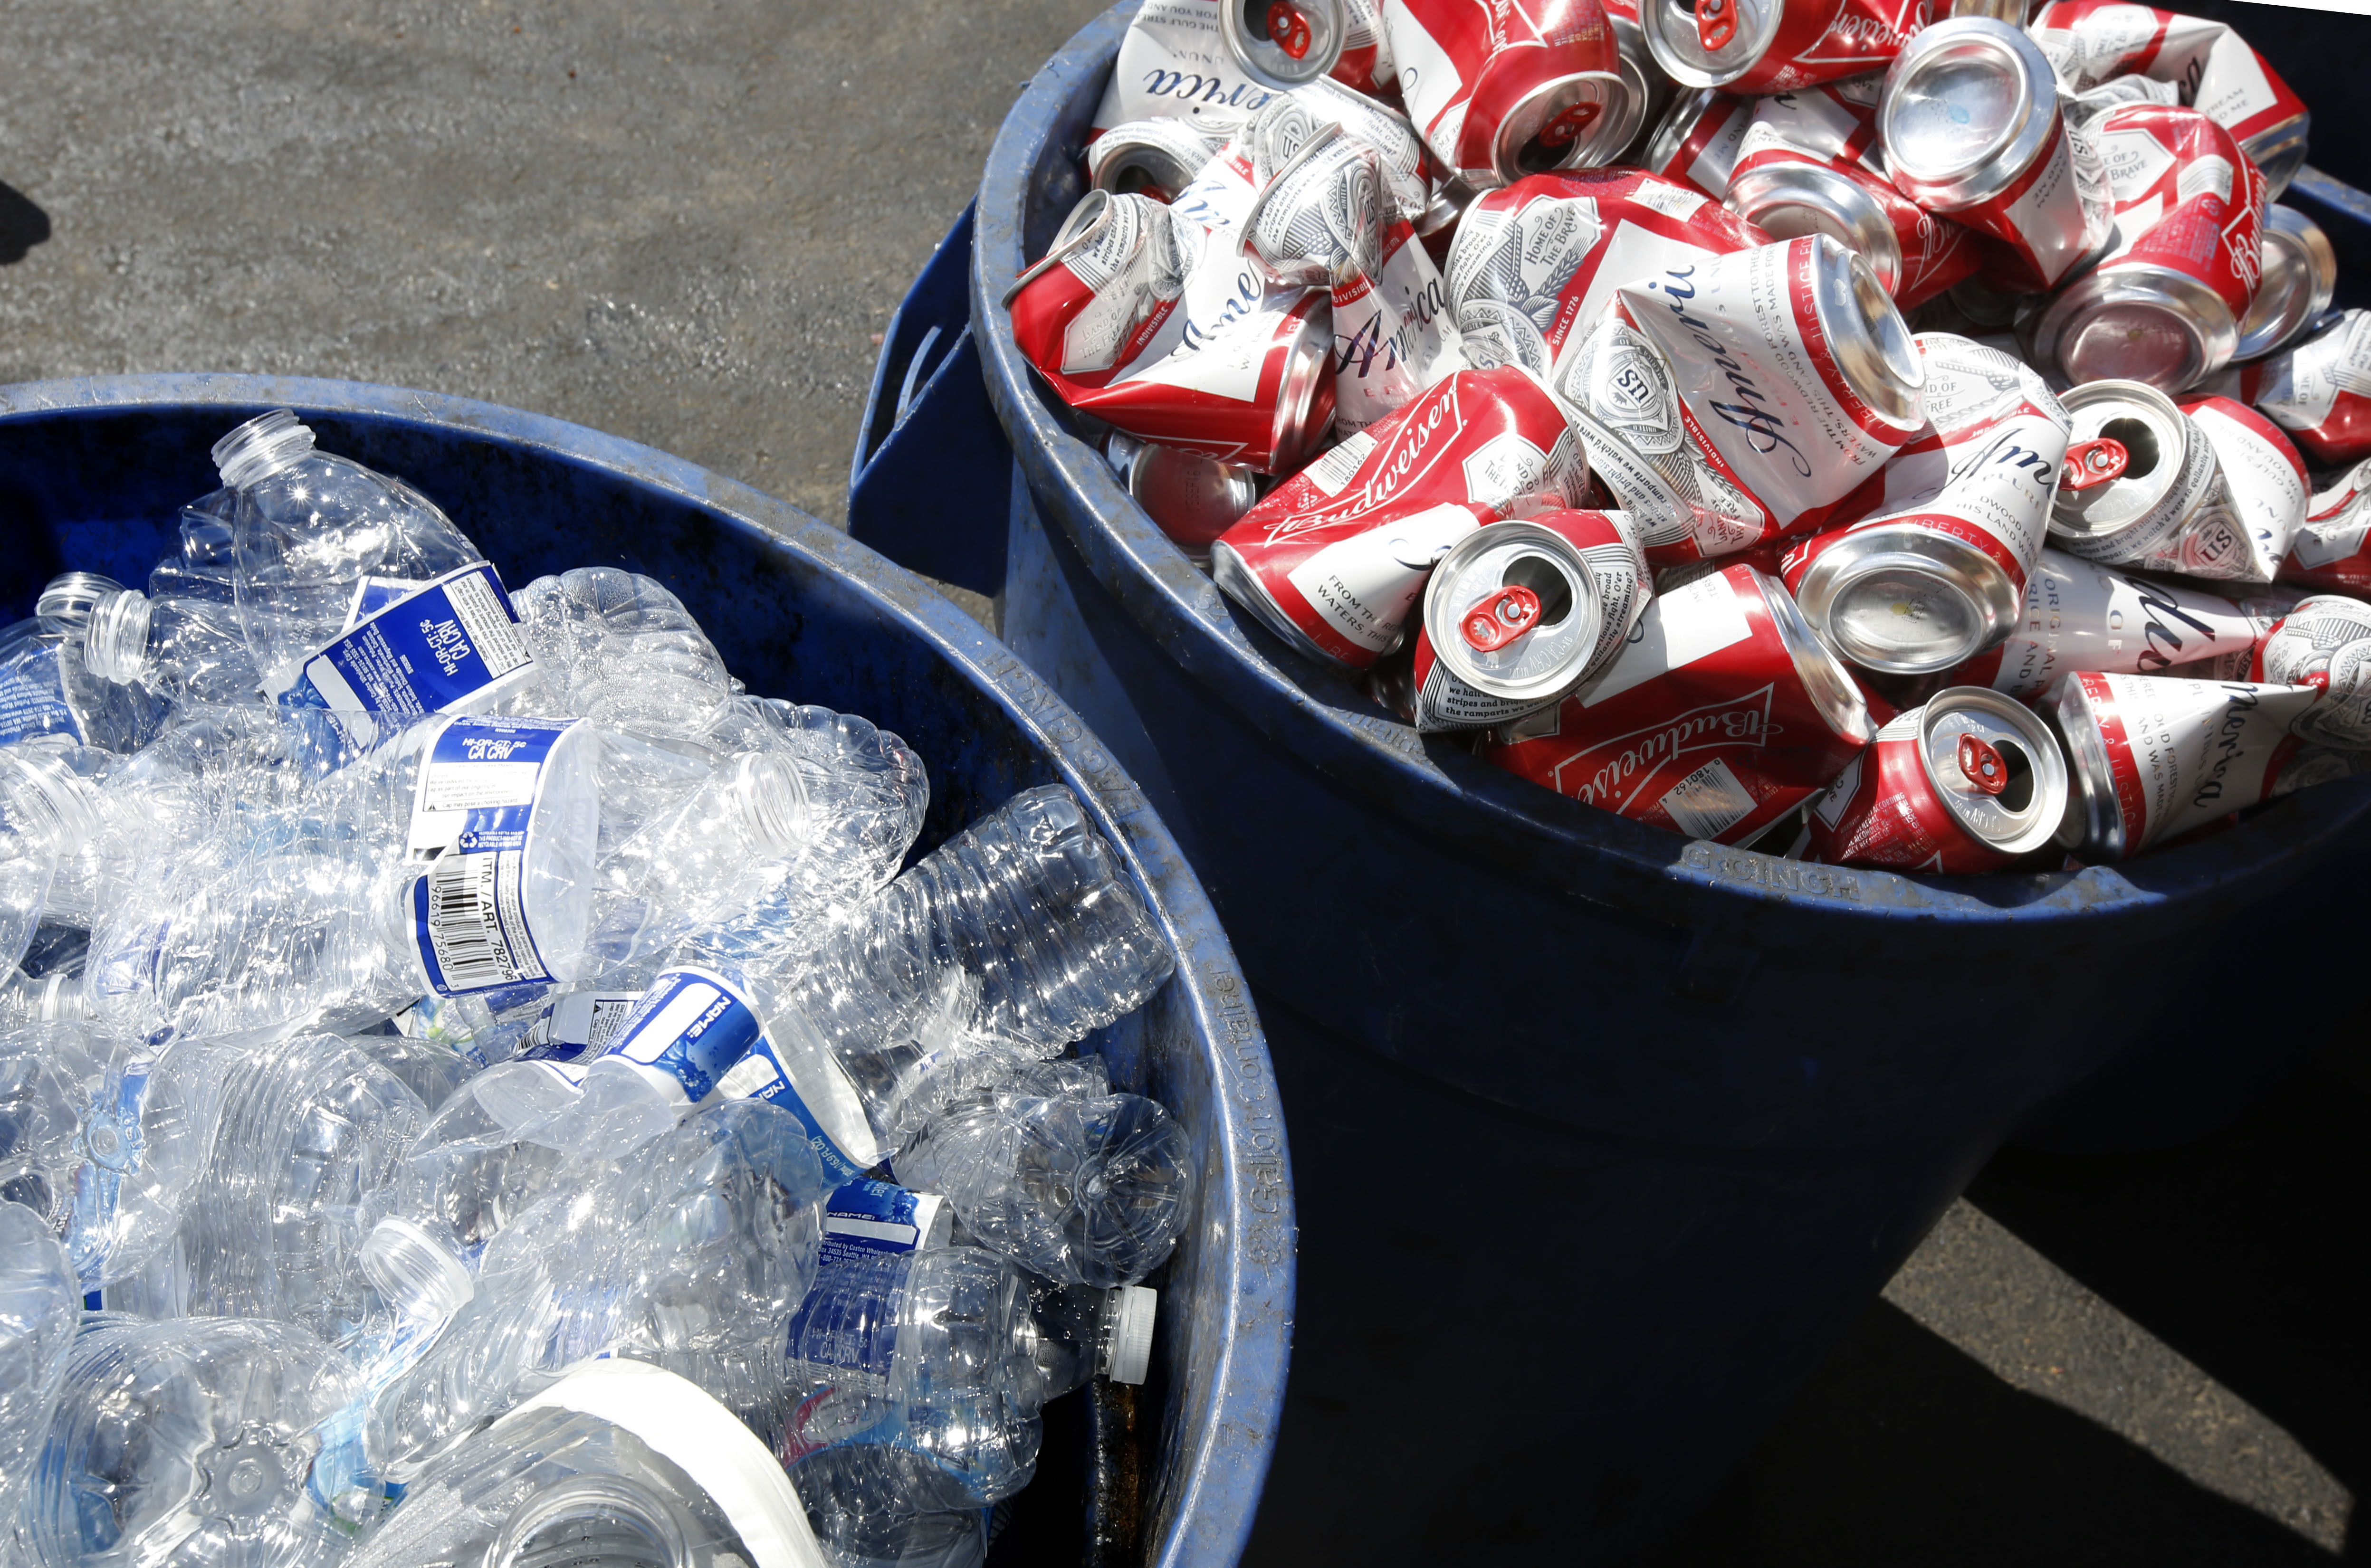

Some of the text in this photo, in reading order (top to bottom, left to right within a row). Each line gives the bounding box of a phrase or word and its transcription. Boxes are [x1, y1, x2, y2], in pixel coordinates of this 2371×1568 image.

[1169, 5, 1216, 21] FOR YOU
[1169, 17, 1197, 29] GULF
[2229, 98, 2251, 111] ME
[1382, 122, 1402, 142] broad
[1384, 133, 1400, 150] O'er
[2109, 160, 2148, 181] BRAVE
[2113, 152, 2127, 163] OF
[2031, 154, 2064, 201] AND ME
[1259, 190, 1291, 238] stripes and
[1260, 194, 1284, 233] we hail'd
[1267, 188, 1308, 244] the ramparts
[1363, 196, 1376, 225] US
[1090, 246, 1102, 259] we
[1096, 224, 1119, 266] stripes and
[1107, 223, 1136, 273] the ramparts
[1456, 233, 1488, 273] fight, O'er
[1460, 230, 1481, 255] broad
[1525, 215, 1558, 266] HOME OF
[1540, 206, 1577, 266] THE BRAVE
[1459, 235, 1498, 281] streaming?
[1129, 305, 1175, 346] INDIVISIBLE
[1463, 322, 1483, 332] STATES
[1552, 295, 1579, 346] SINCE 1776
[1804, 262, 1888, 433] LIBERTY JUSTICE
[1617, 369, 1650, 404] US
[1641, 350, 1666, 390] AMERICA
[1767, 273, 1877, 463] WATERS, THIS LAND WAS MADE
[1945, 382, 1958, 391] OF
[1757, 306, 1865, 469] FROM THE REDWOOD FOREST
[1263, 382, 1460, 533] Budweiser
[1684, 415, 1725, 468] INDIVISIBLE
[2236, 436, 2290, 474] AND YOU
[1340, 453, 1367, 486] 180162
[1578, 426, 1670, 505] ramparts we watch'd were
[1607, 465, 1633, 490] bright
[2251, 458, 2286, 488] GULF
[1629, 485, 1646, 502] and
[1642, 497, 1670, 523] stripes
[1714, 494, 1745, 520] FREE
[2100, 445, 2203, 552] and bright stars through the perilous
[2130, 453, 2213, 549] we watch'd were so gallantly
[1645, 517, 1657, 528] we
[1705, 497, 1736, 549] LAND OF
[1986, 514, 2035, 567] LAND WAS
[2200, 532, 2233, 562] US
[1328, 574, 1384, 627] FROM THE
[1597, 572, 1616, 599] broad
[454, 584, 484, 631] bottle cap?
[463, 620, 472, 631] Less
[1316, 584, 1389, 643] WATERS, THIS
[1591, 571, 1636, 668] gallantly streaming?
[1593, 571, 1625, 656] perilous fight, O'er
[2043, 577, 2063, 675] ORIGINAL
[343, 638, 353, 649] USA
[361, 634, 377, 657] Potassium
[418, 617, 459, 676] HI-OR-CT: 5¢
[434, 616, 471, 661] CA CRV
[2018, 583, 2042, 679] RICE AND
[342, 647, 377, 698] Costco Wholesale Corp.
[357, 645, 382, 683] www.costco.com
[365, 629, 419, 716] Bicarbonate, Sodium Bicarbonate, Calcium
[368, 621, 418, 702] Sodium Chloride and Magnesium Oxide
[1446, 706, 1461, 715] the
[1464, 708, 1509, 718] ramparts
[1447, 697, 1477, 707] stripes
[462, 738, 512, 747] HI-OR-CT:
[468, 746, 514, 760] CA CRV
[1673, 766, 1713, 796] 180162
[2148, 749, 2163, 780] WAS
[1871, 788, 1906, 817] ACCORDING
[1853, 821, 1882, 846] ALCOHOLIC
[1858, 829, 1884, 852] BECAUSE
[1726, 853, 1863, 904] CINCH
[480, 857, 517, 981] ITM. ART. 782796
[505, 896, 513, 919] standards
[513, 912, 522, 929] product
[430, 886, 453, 971] 96619 75680
[685, 995, 733, 1039] NAME:
[1198, 965, 1281, 1215] Gallon Container
[826, 1212, 876, 1221] NAME:
[849, 1244, 865, 1252] Costco
[832, 1402, 852, 1420] CRV
